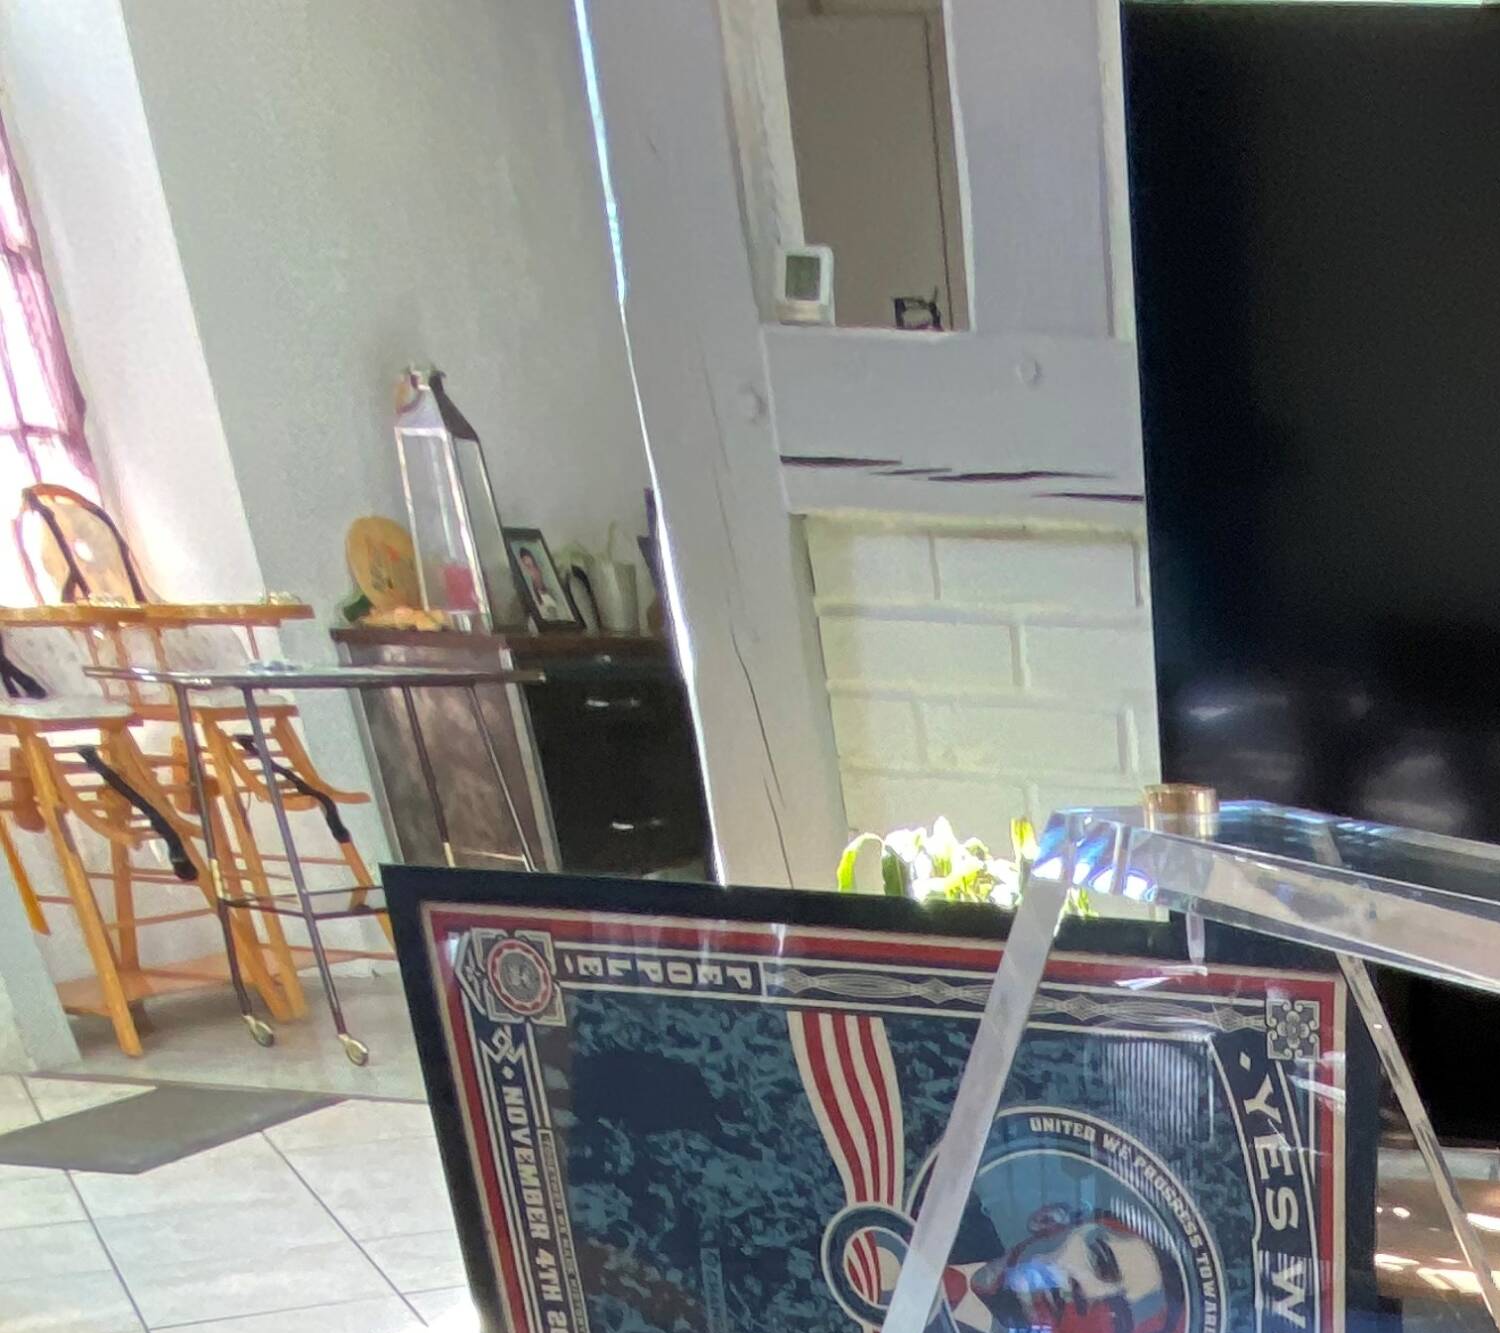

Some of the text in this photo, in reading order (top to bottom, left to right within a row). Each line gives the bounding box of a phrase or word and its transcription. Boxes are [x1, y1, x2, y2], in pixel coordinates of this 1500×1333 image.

[502, 1086, 551, 1240] NOVEMBER
[535, 1248, 564, 1302] 4TH
[1029, 1116, 1097, 1143] UNITED
[1102, 1132, 1133, 1161] WE
[1243, 1073, 1299, 1231] YES
